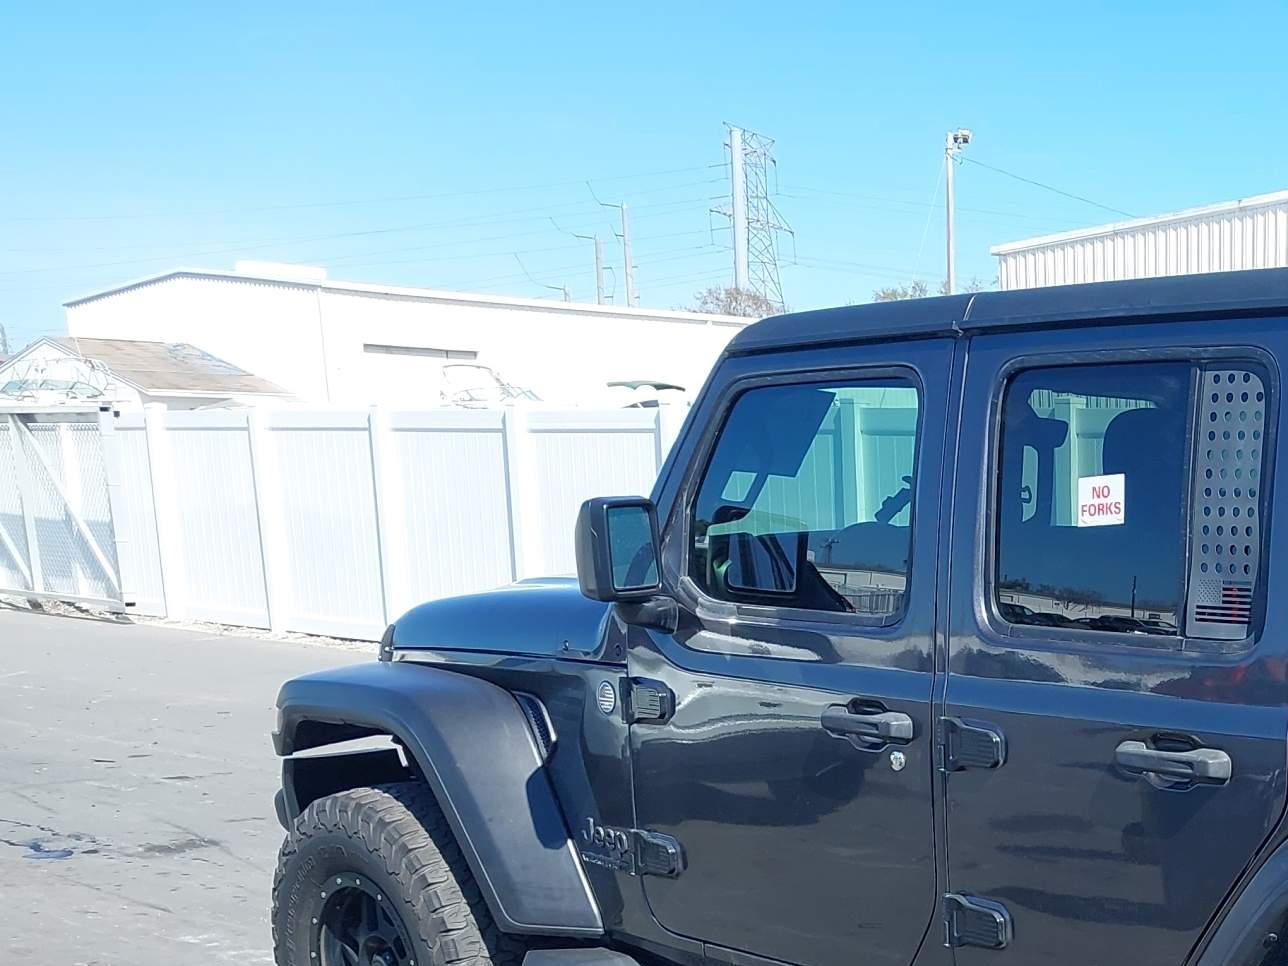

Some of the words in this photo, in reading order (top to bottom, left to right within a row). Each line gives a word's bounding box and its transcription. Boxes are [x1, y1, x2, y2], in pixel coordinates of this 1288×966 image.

[1091, 485, 1111, 499] NO
[1080, 501, 1122, 518] FORKS
[581, 816, 628, 858] Jeep
